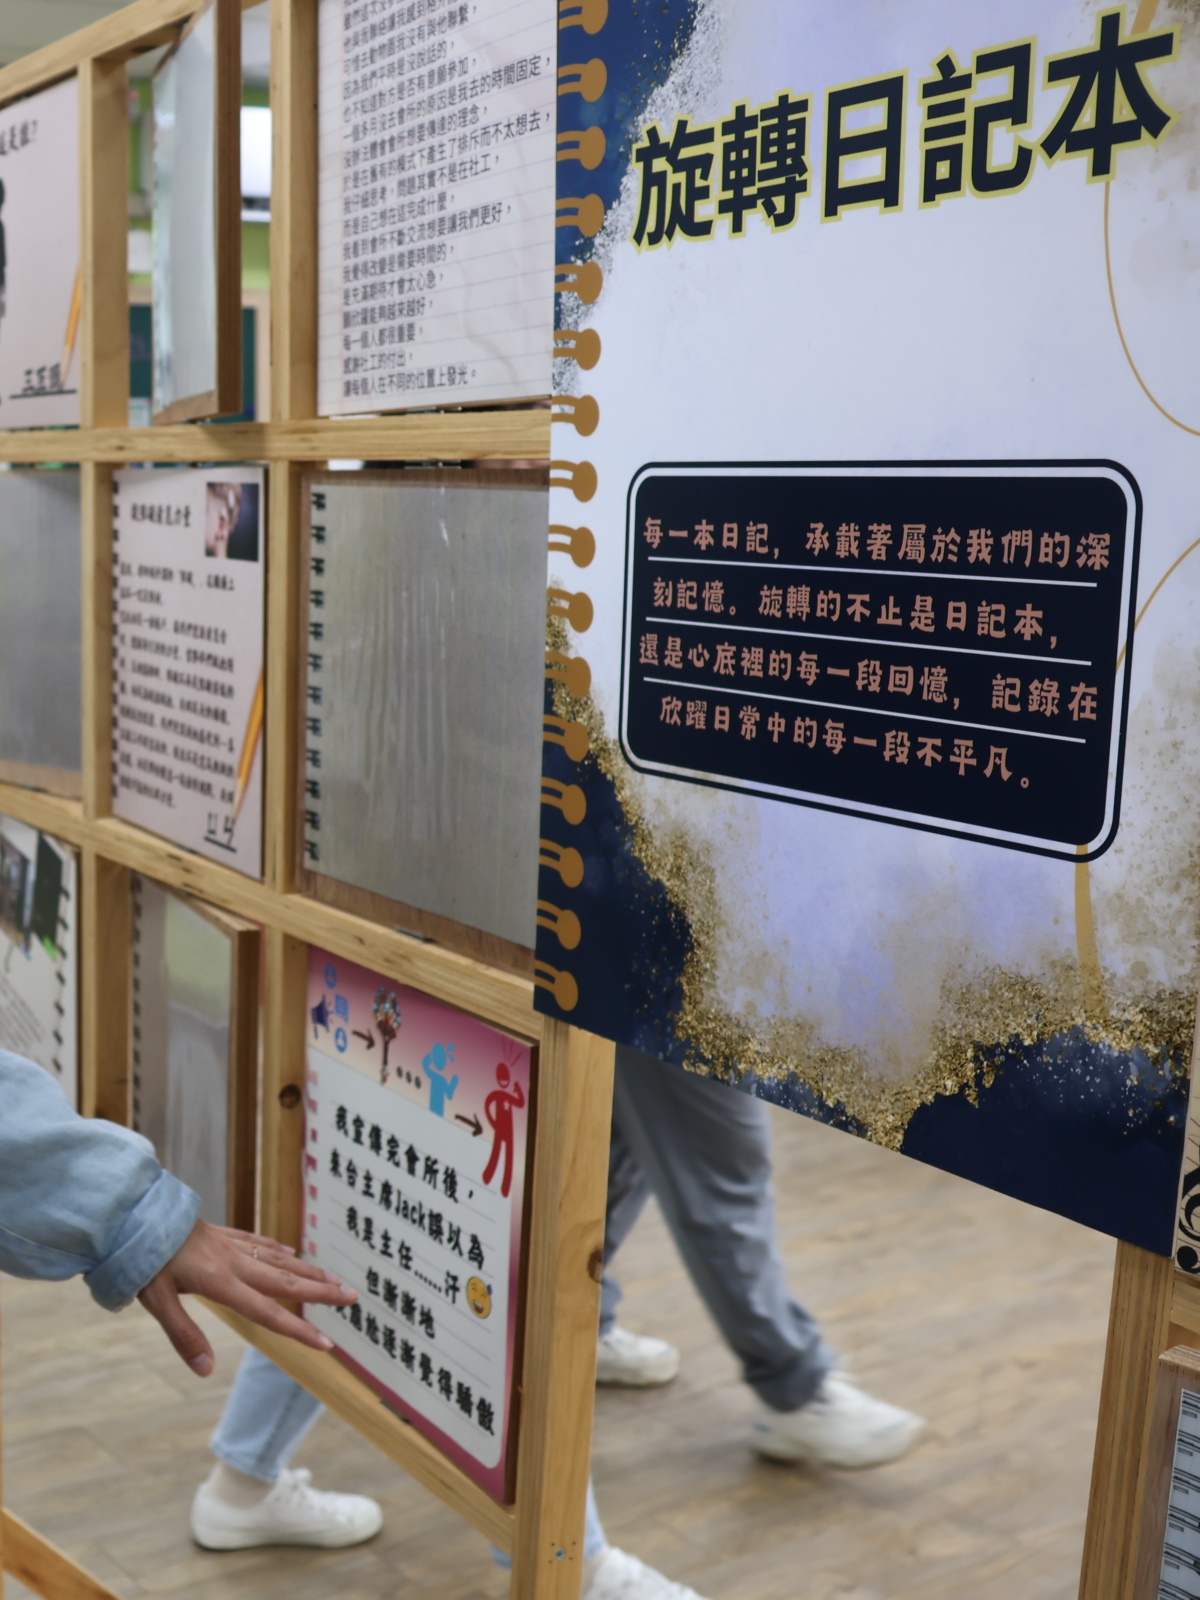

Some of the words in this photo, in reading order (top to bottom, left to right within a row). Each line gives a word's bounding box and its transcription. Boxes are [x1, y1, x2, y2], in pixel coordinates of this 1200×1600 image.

[632, 9, 1177, 250] 旋轉日記本
[643, 517, 1111, 570] 每一本日記，承載著屬於我們的深
[652, 576, 1058, 649] 刻記憶。旋轉的不止是日記本，
[659, 695, 1030, 789] 欣躍日常中的每一段不平凡。
[366, 1267, 436, 1340] 但漸漸地
